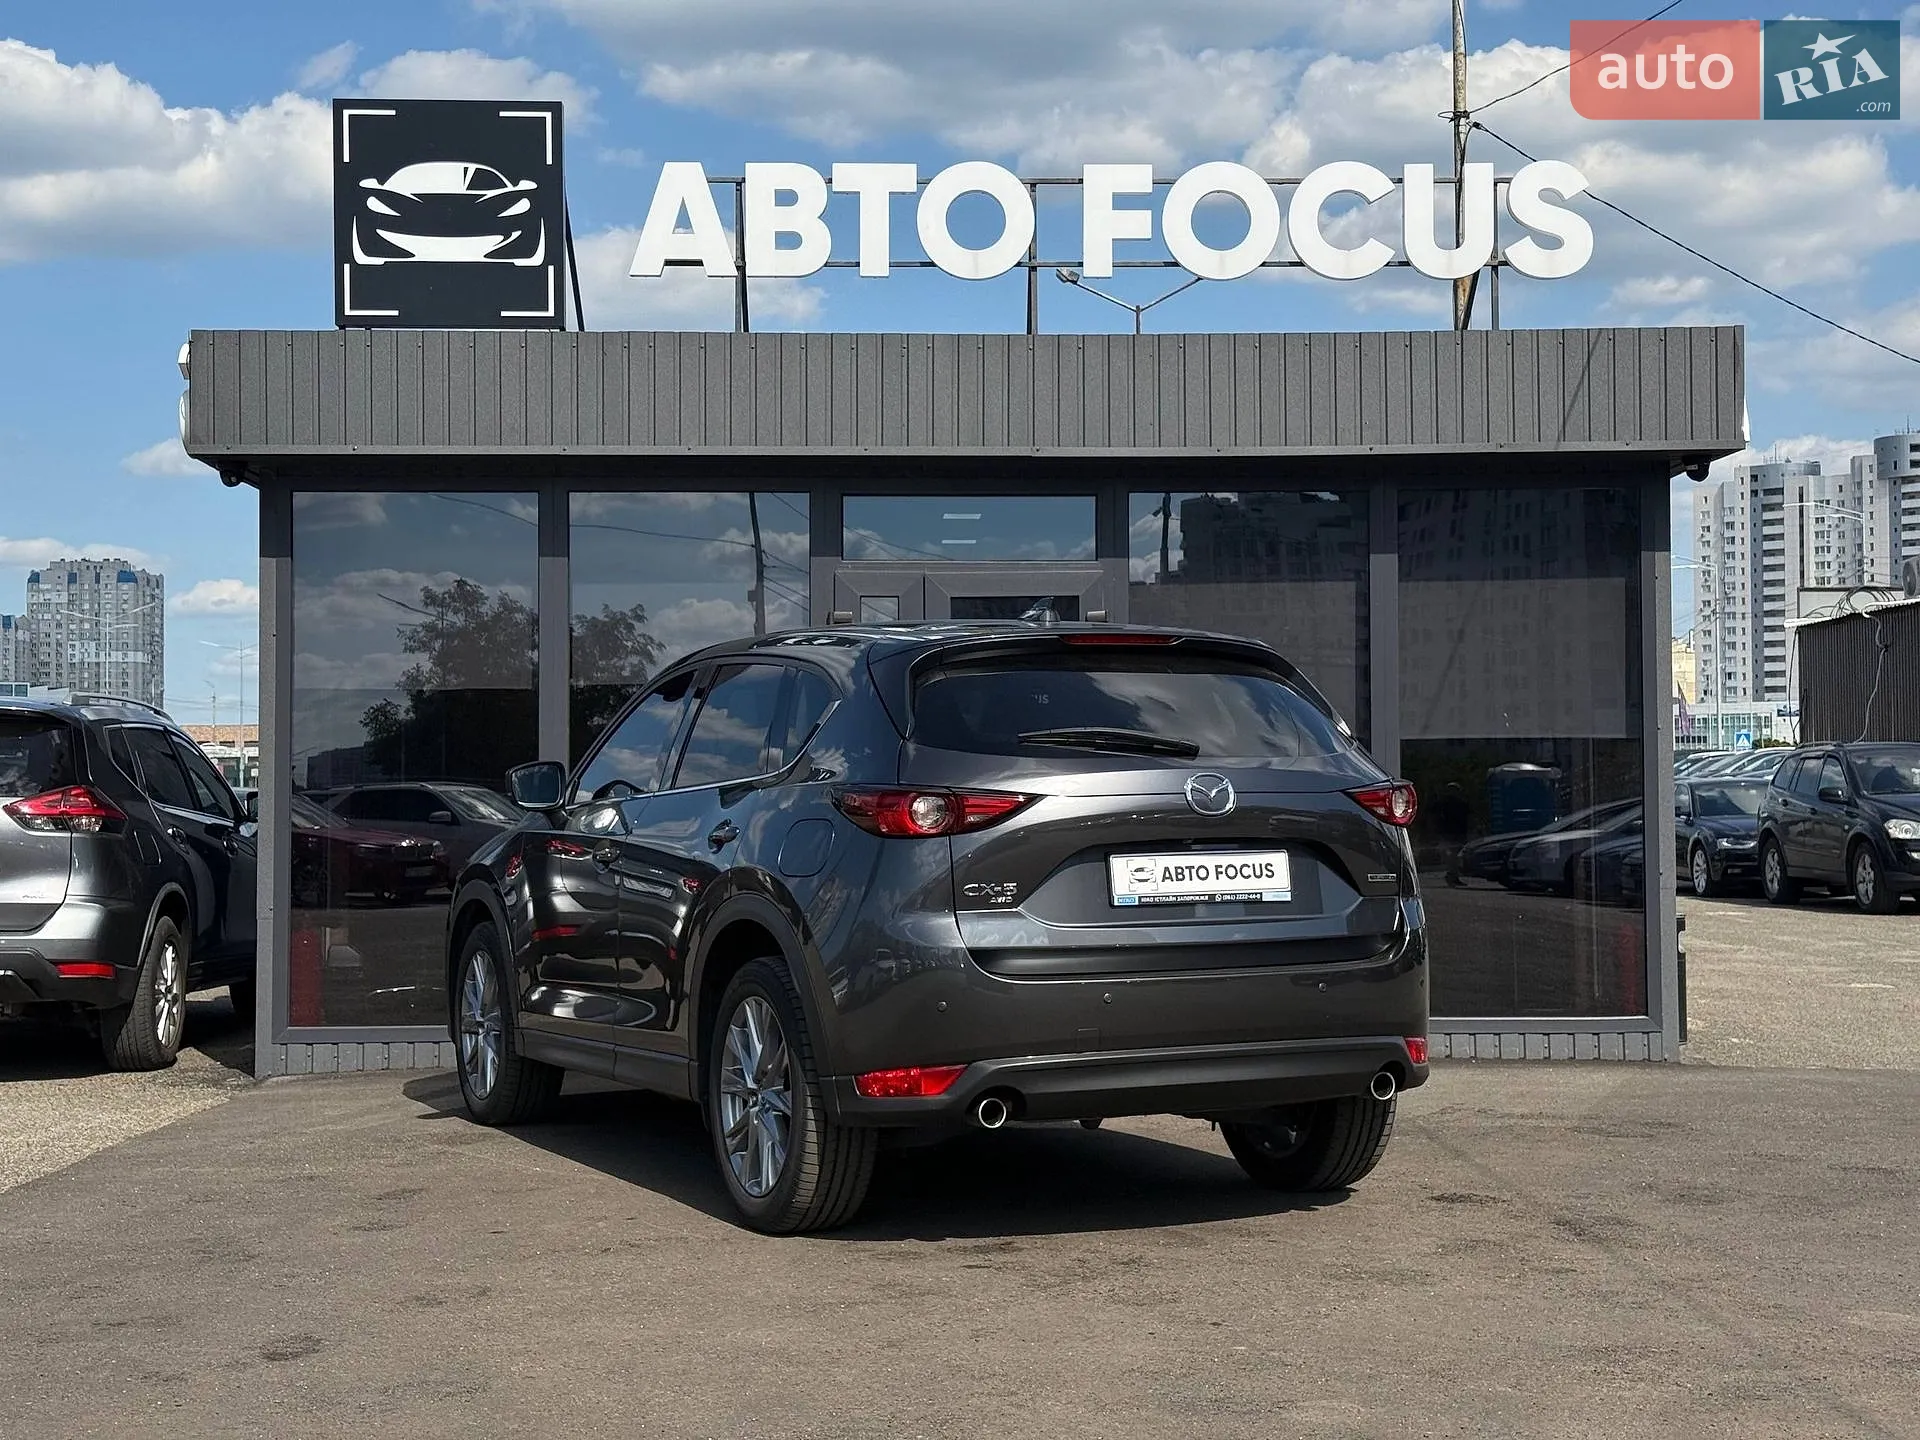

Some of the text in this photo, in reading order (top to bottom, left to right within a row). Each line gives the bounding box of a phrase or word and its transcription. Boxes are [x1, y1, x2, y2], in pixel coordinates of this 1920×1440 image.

[629, 160, 1595, 280] АВТО FOCUS
[1161, 862, 1275, 882] АВТО FOCUS
[963, 882, 1018, 896] CX-5
